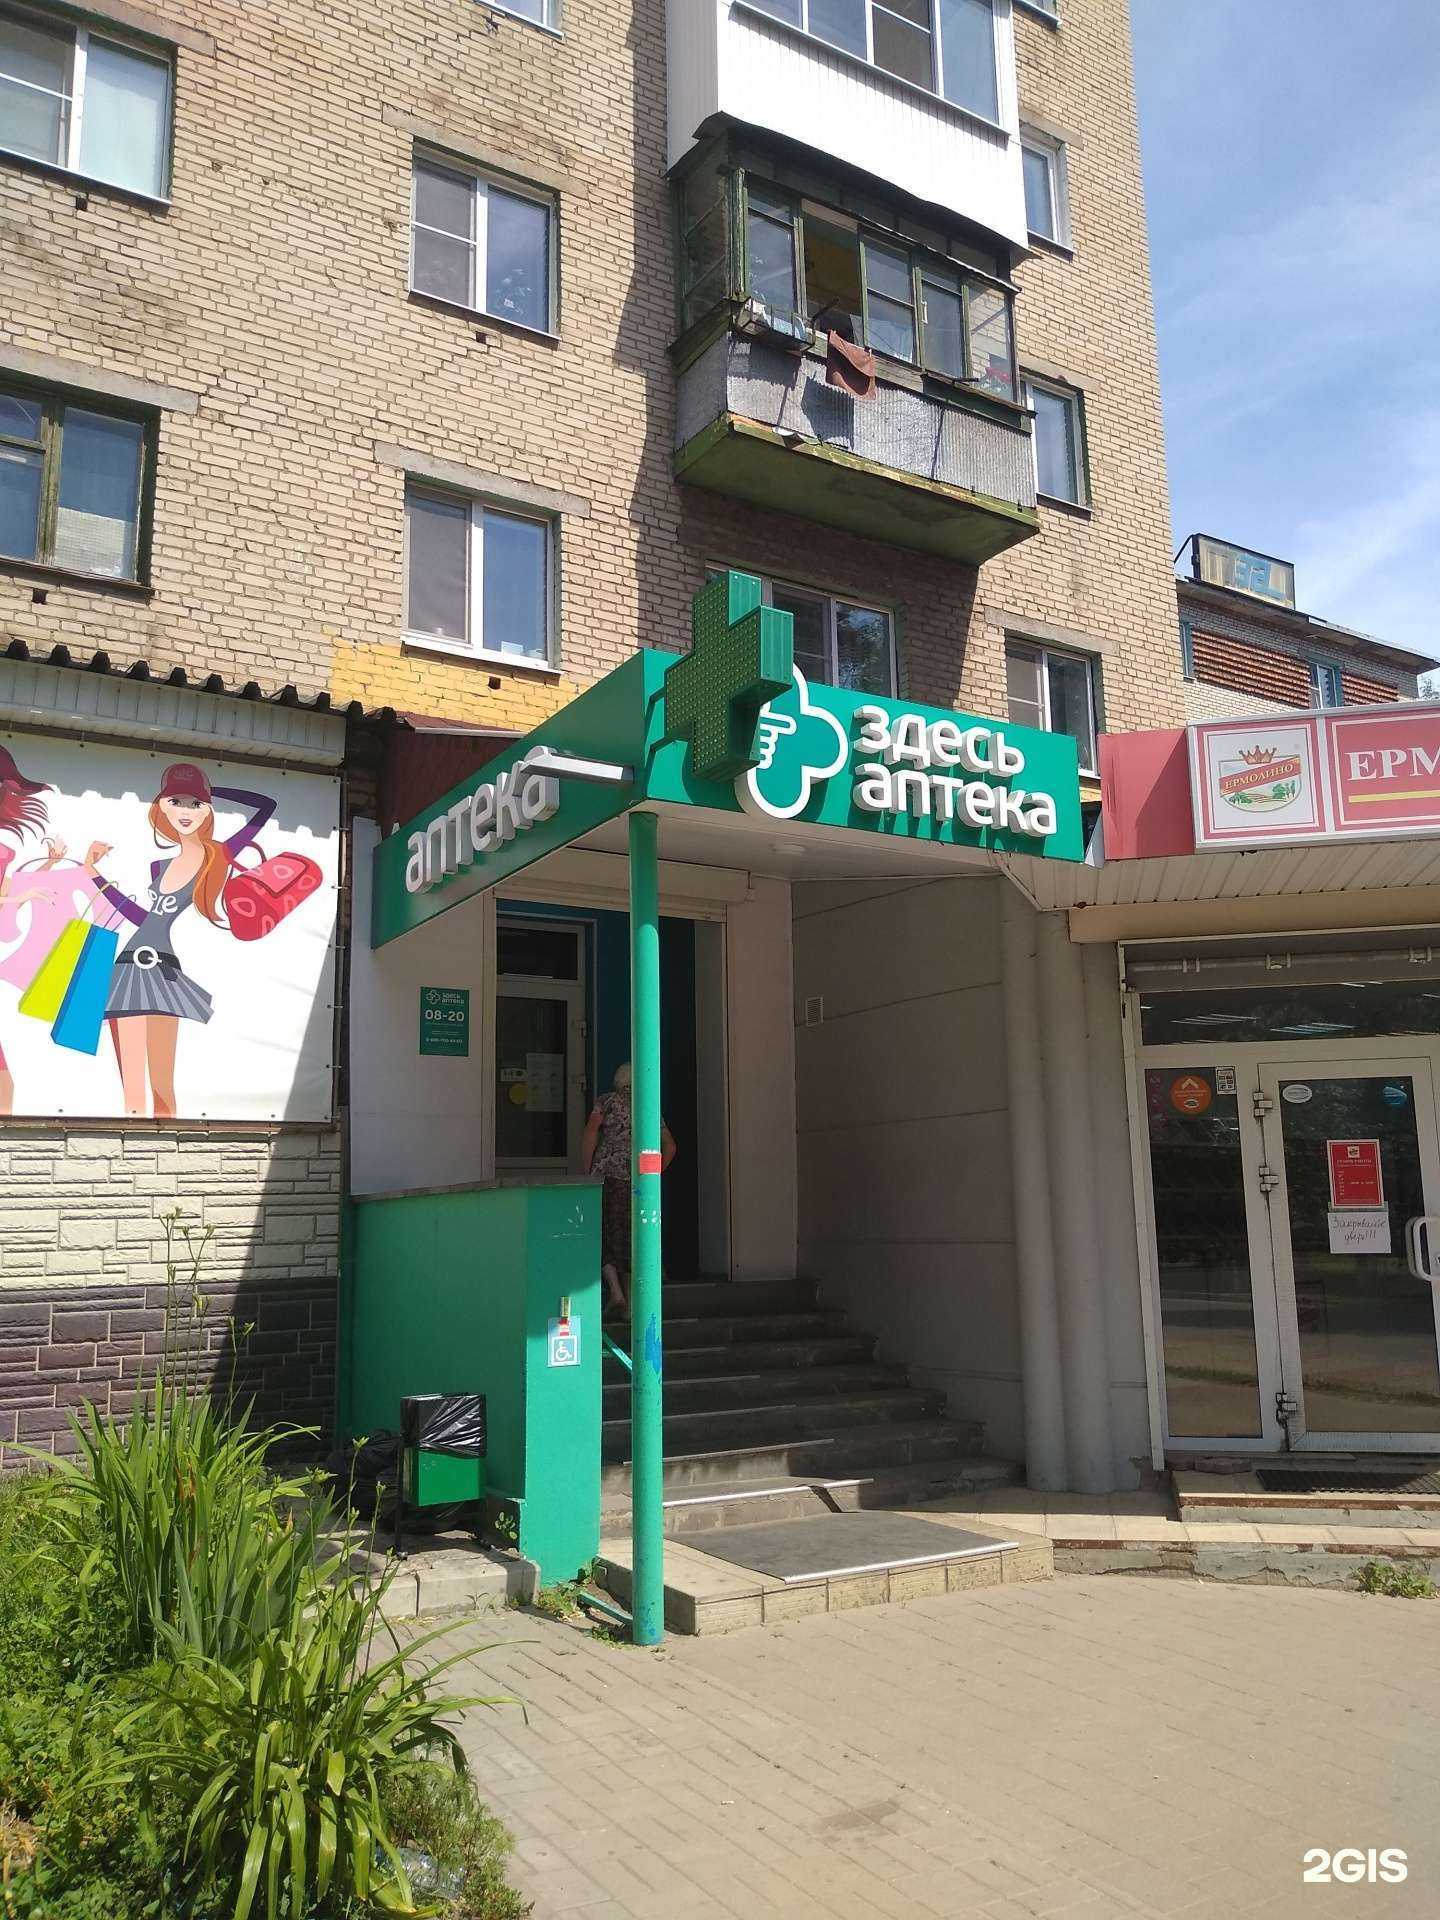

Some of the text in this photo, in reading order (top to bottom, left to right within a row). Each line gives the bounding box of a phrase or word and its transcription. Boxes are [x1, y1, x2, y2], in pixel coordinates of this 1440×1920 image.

[853, 705, 1025, 777] здесь
[1225, 763, 1294, 789] ЕРМОЛИНО
[405, 746, 560, 894] аптека
[853, 763, 1057, 837] аптека
[425, 1009, 465, 1022] 08-20
